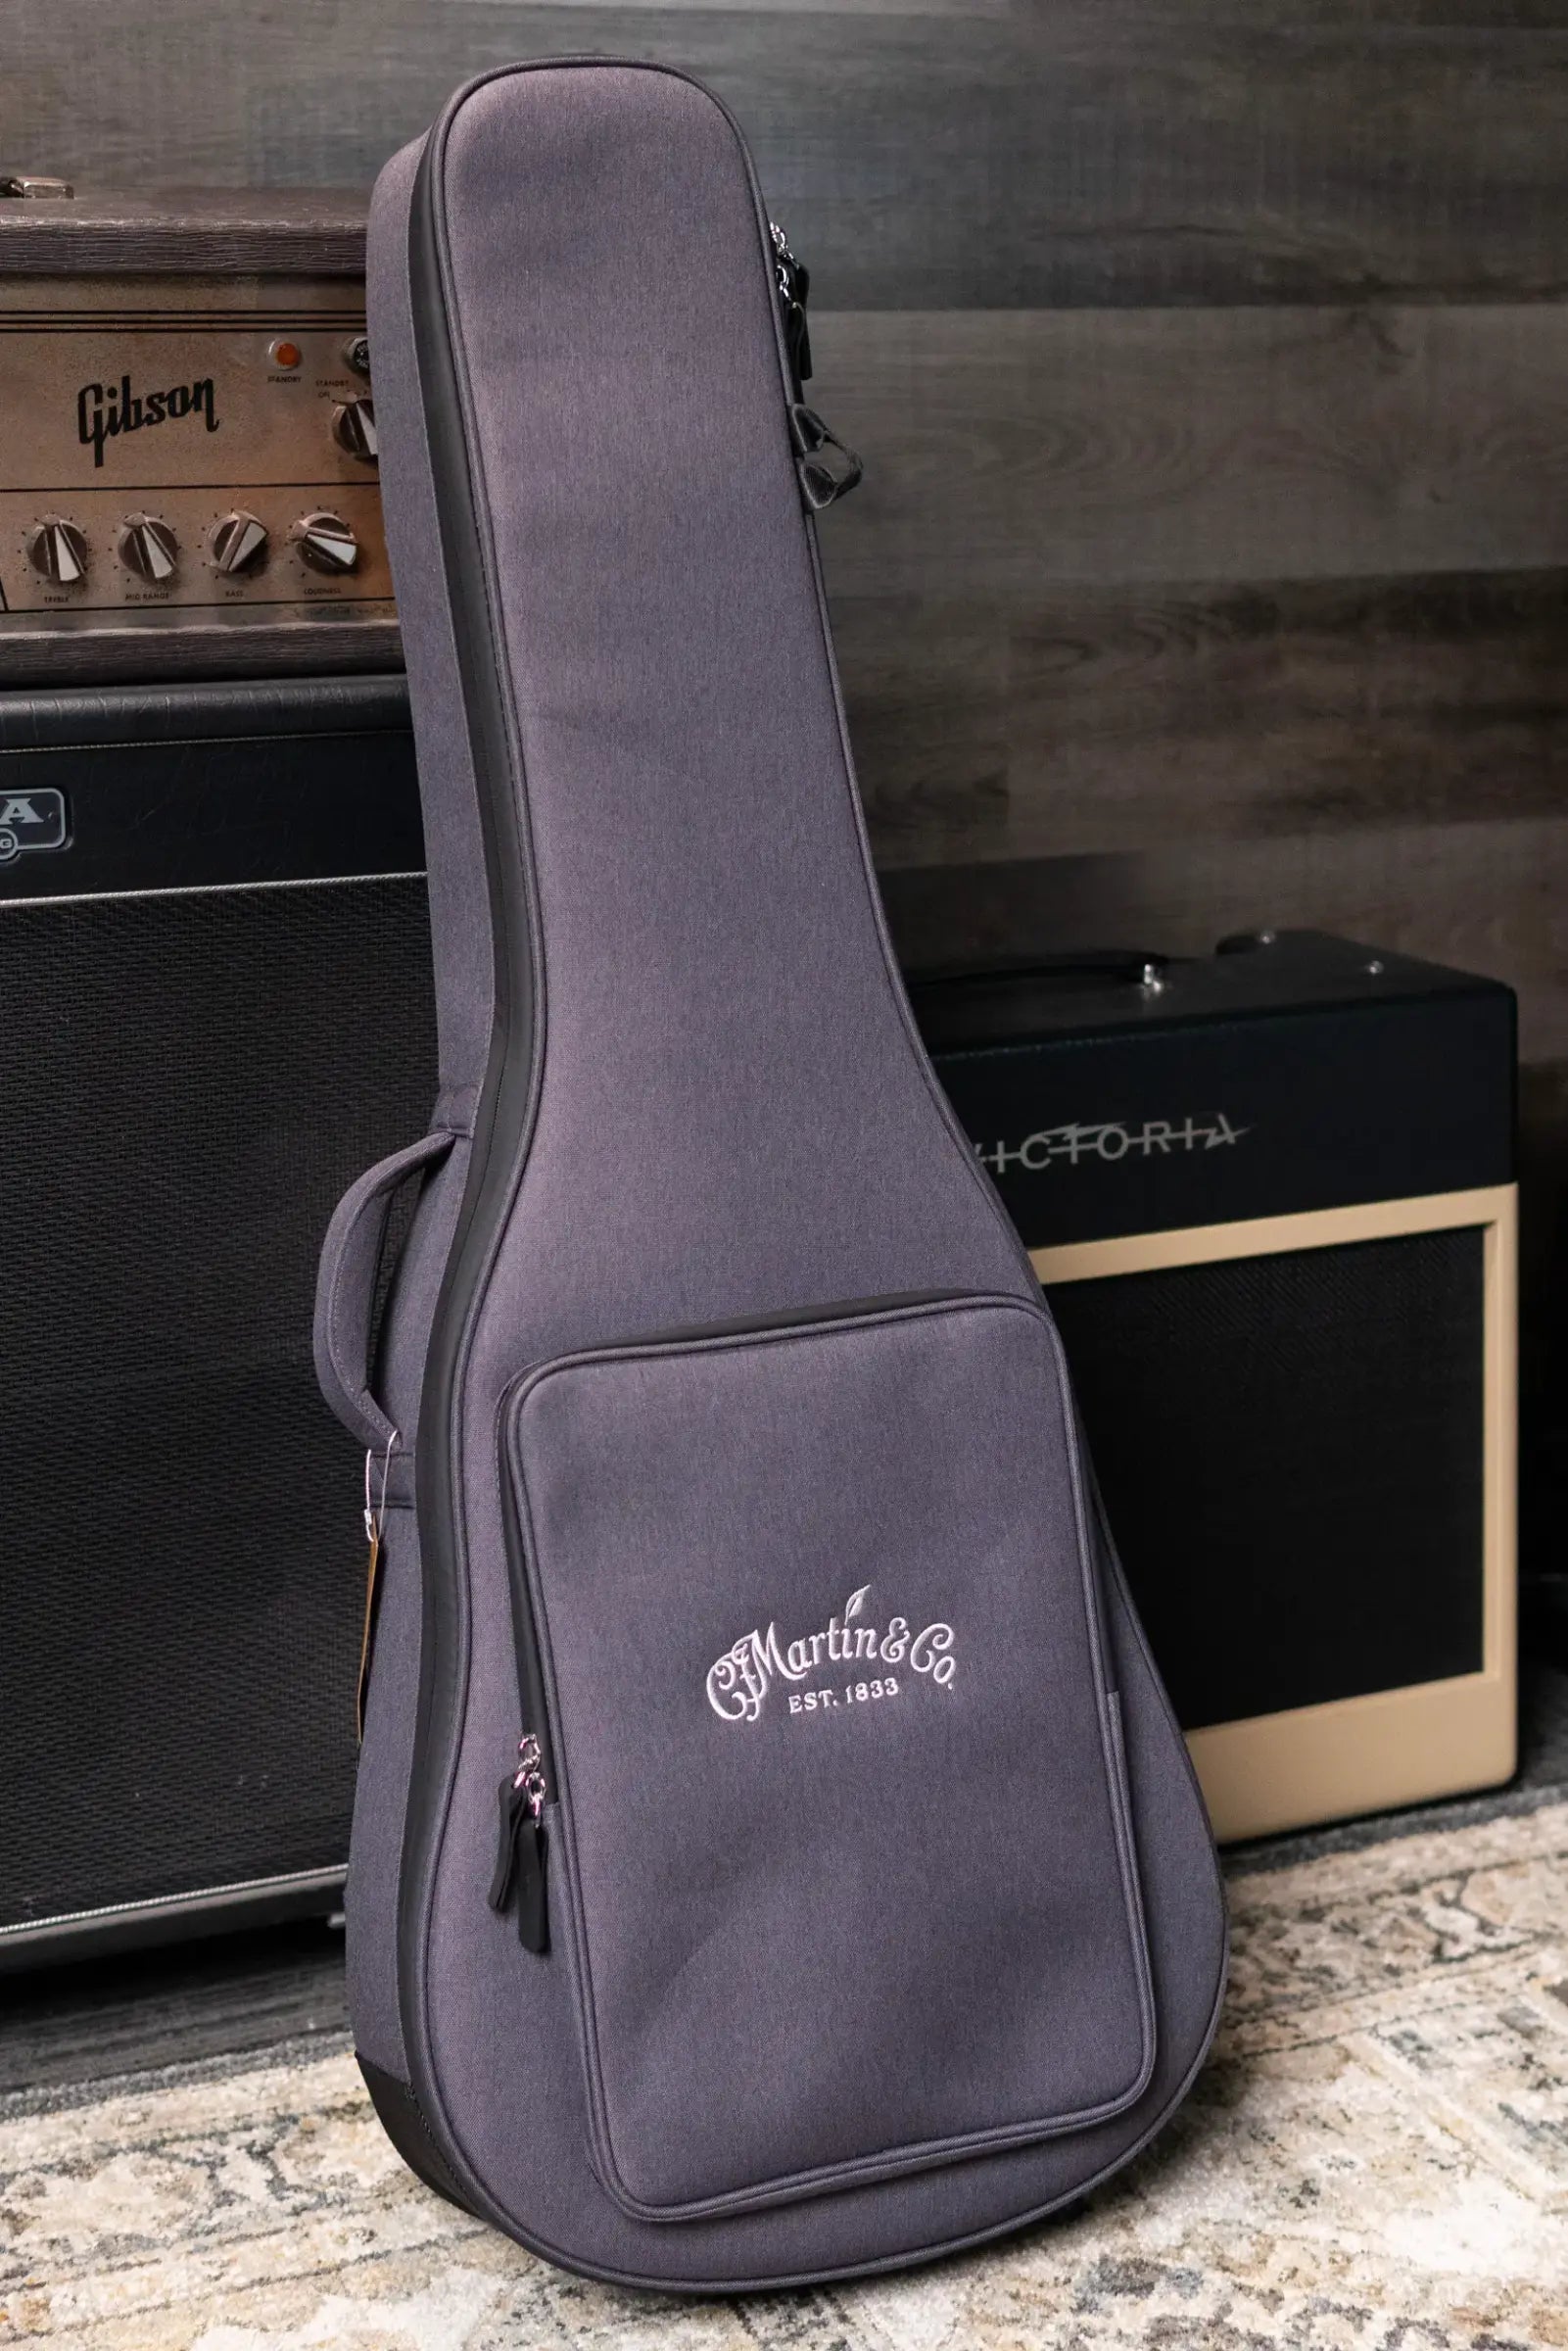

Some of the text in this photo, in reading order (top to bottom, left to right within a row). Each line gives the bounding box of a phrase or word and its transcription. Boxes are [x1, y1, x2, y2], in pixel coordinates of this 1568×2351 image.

[77, 375, 220, 468] Gibson
[787, 1676, 900, 1714] EST. 1833
